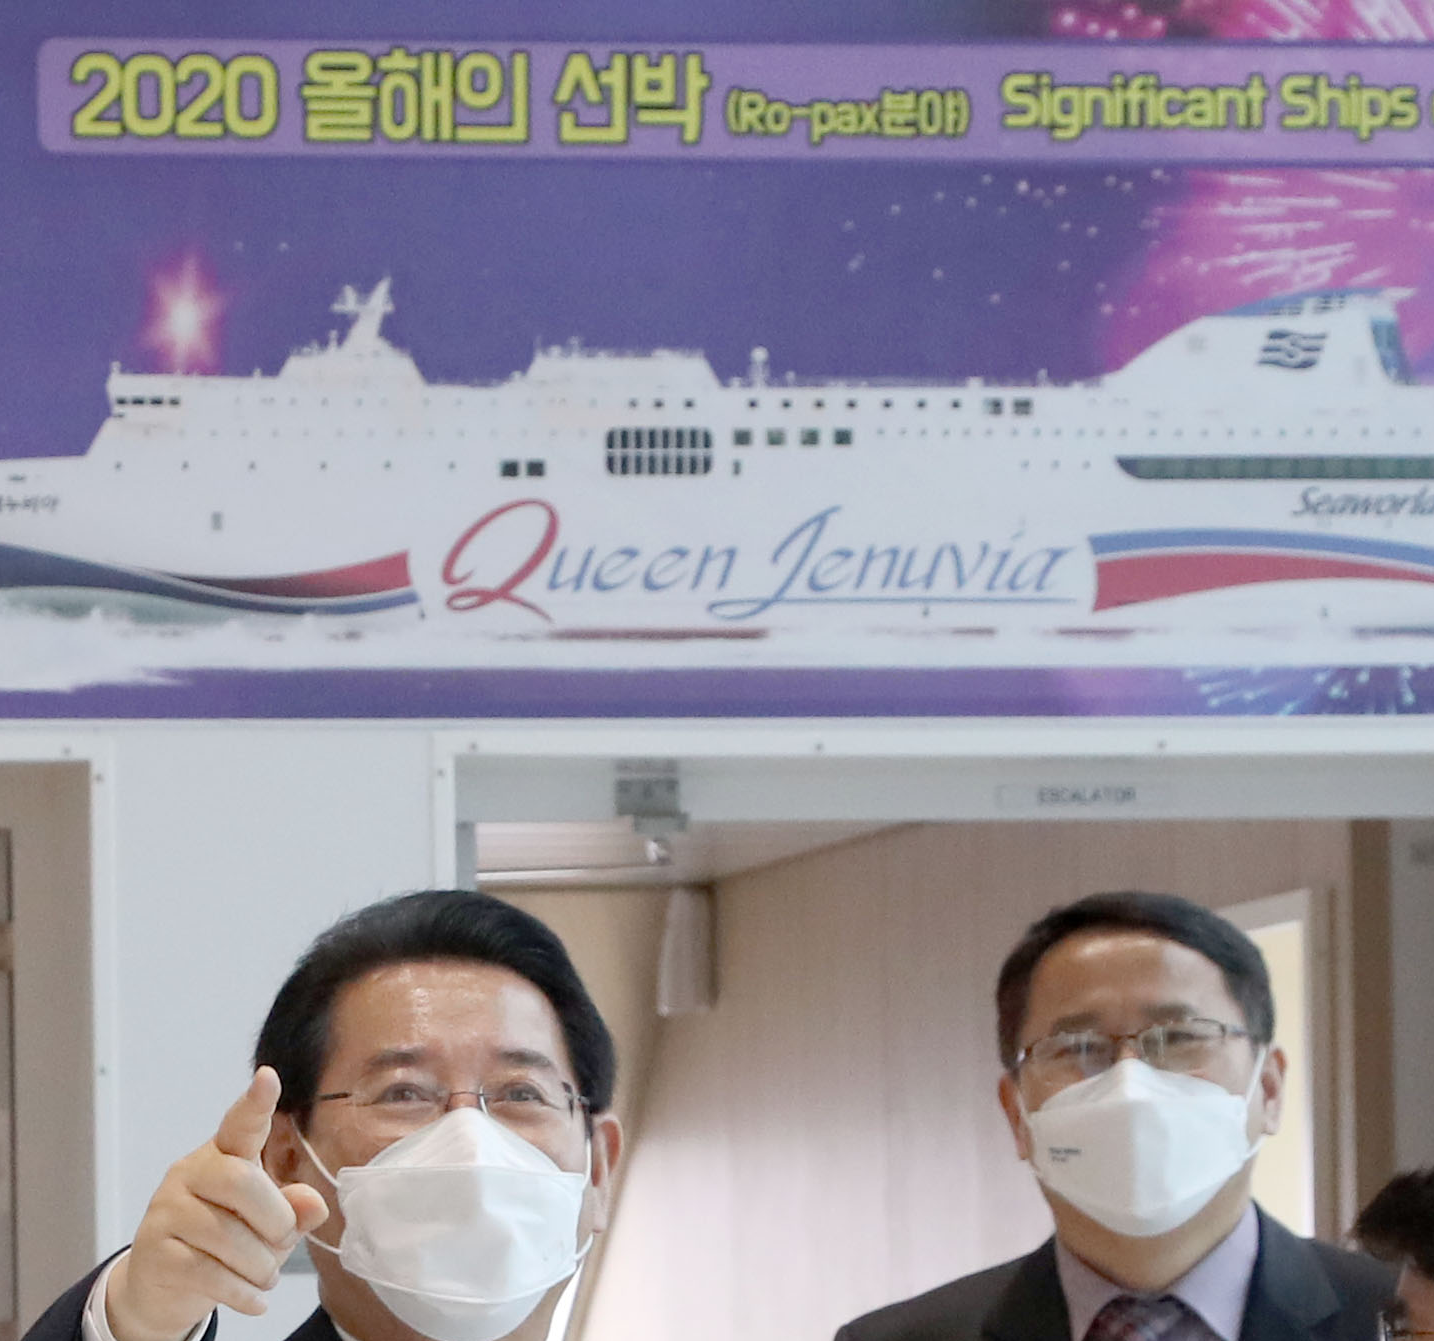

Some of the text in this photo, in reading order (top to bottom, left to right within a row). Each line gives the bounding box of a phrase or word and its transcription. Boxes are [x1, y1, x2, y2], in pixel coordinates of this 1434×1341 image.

[70, 51, 279, 139] 2020
[301, 48, 529, 143] 올해의
[554, 51, 711, 144] 선박
[724, 87, 971, 145] (Ro-pax분야)
[1000, 71, 1266, 141] Significant
[1279, 72, 1421, 142] Ships
[442, 499, 740, 623] Queen
[1038, 787, 1137, 803] ESCALATOR
